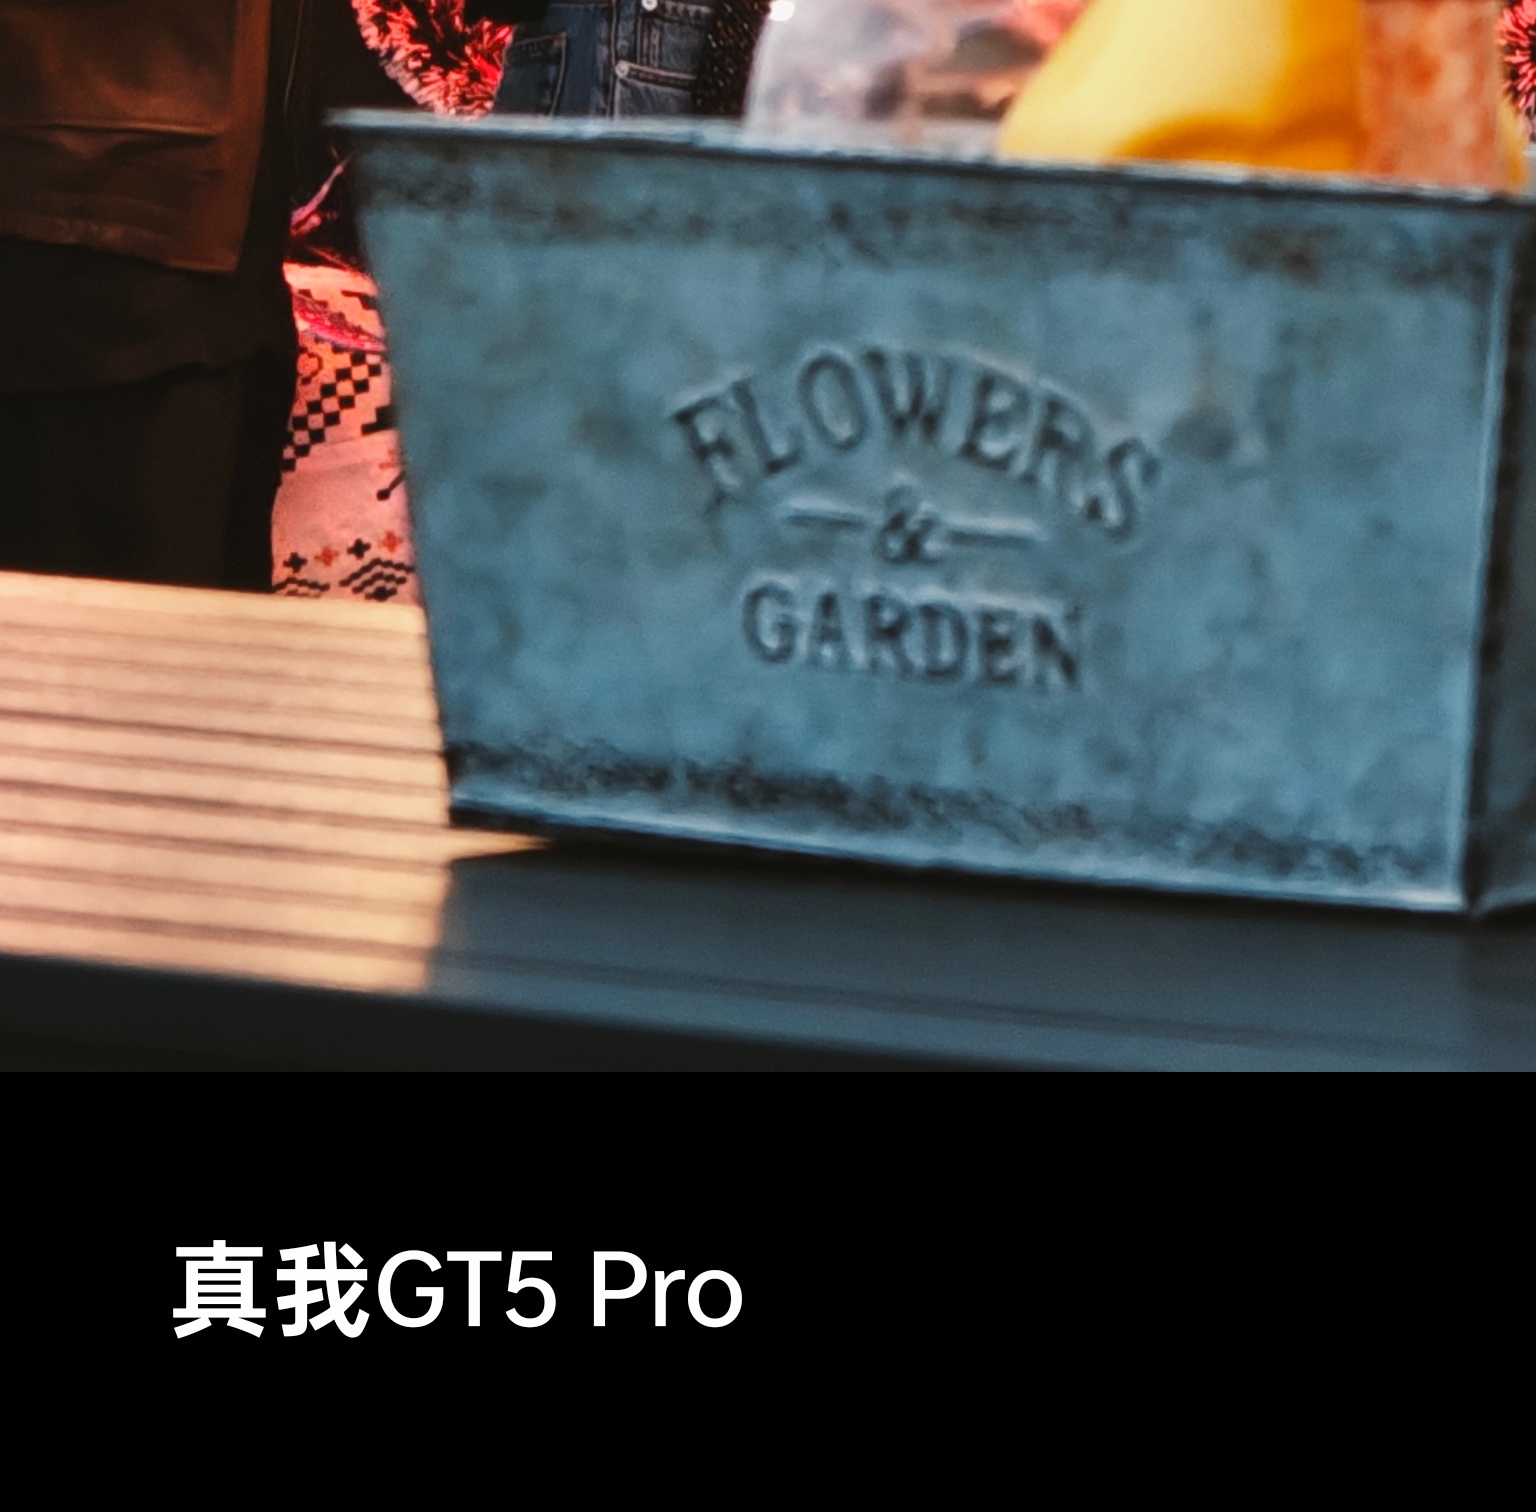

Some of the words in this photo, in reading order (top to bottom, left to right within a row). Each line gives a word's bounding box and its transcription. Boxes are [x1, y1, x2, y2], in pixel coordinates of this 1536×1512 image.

[672, 348, 1162, 541] FLOWERS
[878, 485, 943, 566] &
[741, 580, 1088, 691] GARDEN
